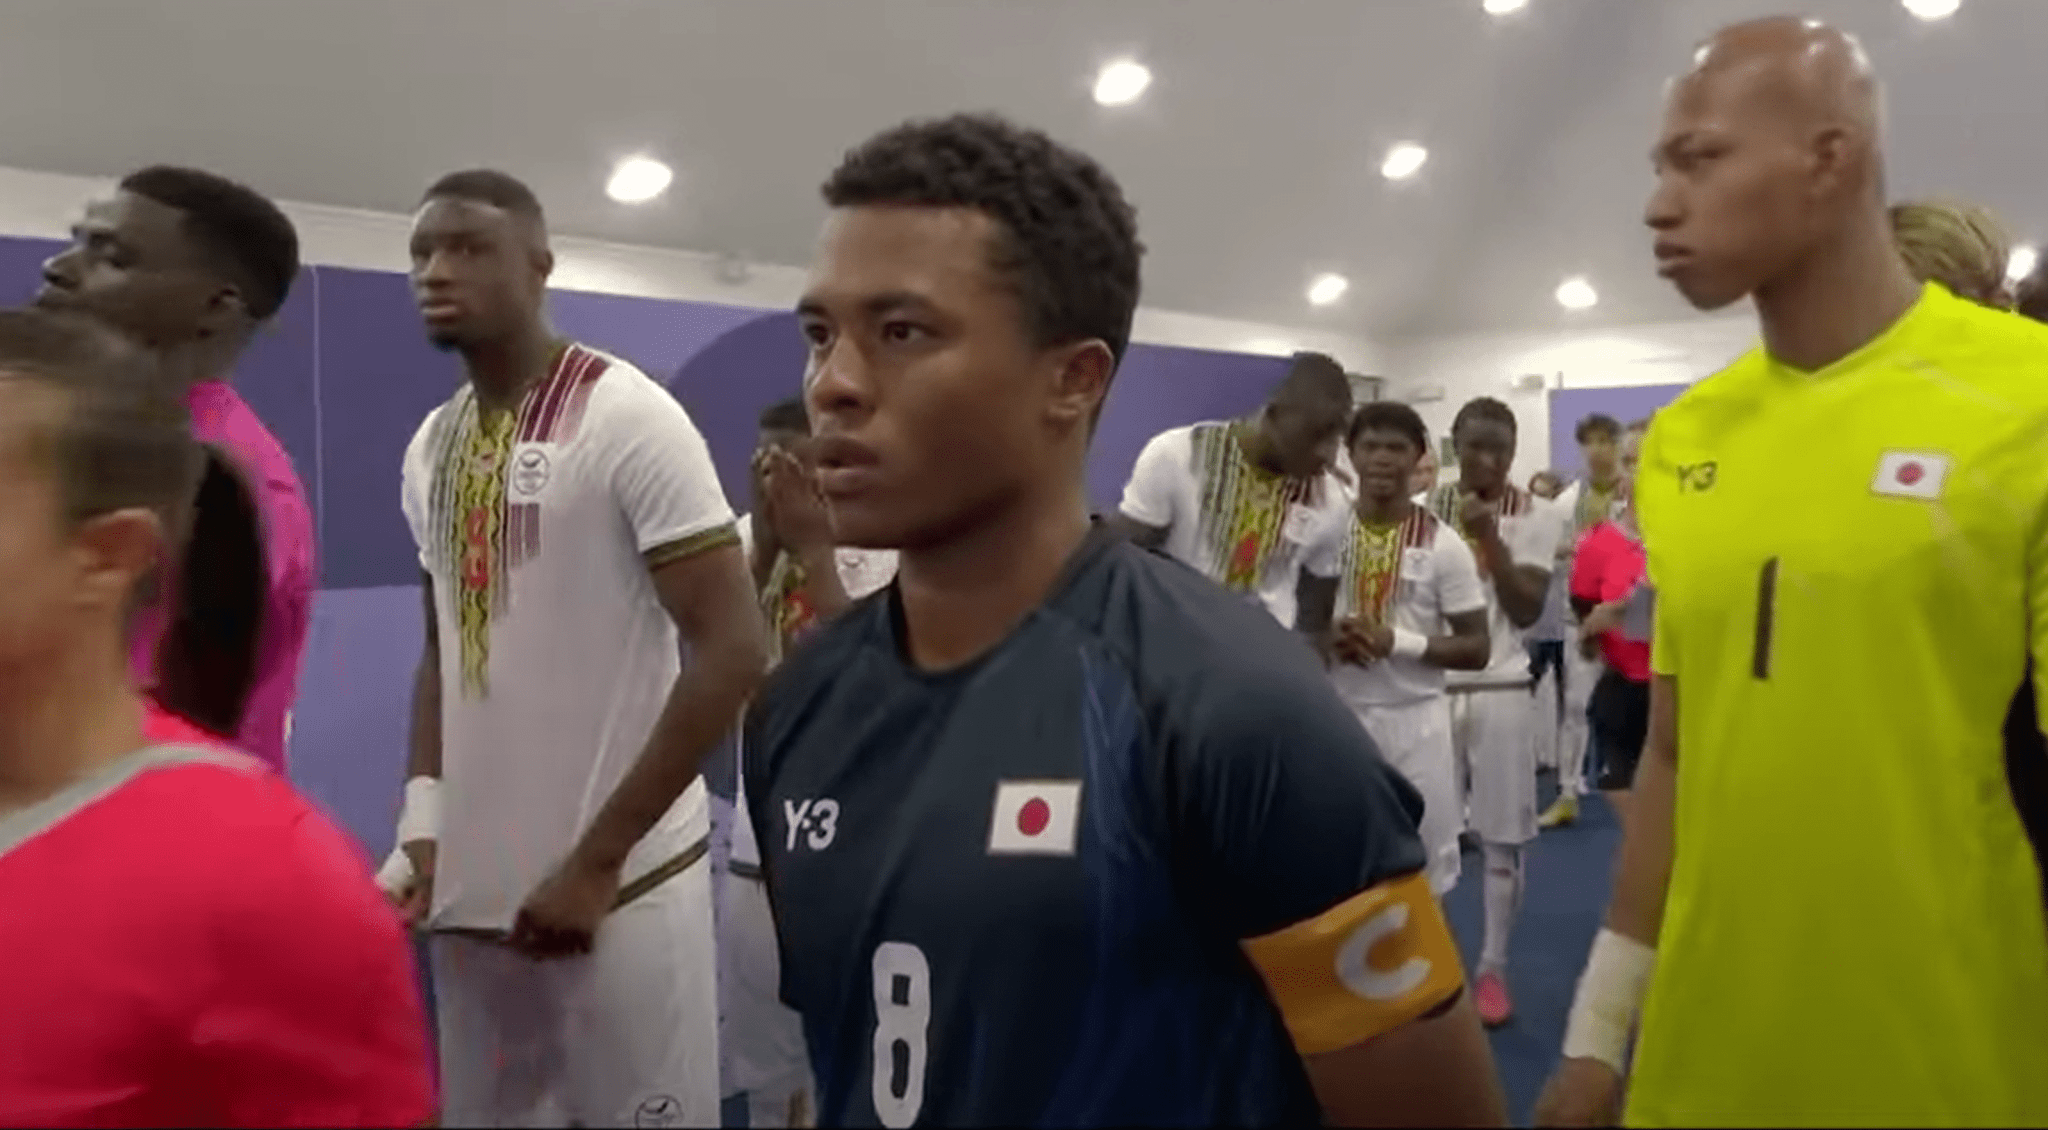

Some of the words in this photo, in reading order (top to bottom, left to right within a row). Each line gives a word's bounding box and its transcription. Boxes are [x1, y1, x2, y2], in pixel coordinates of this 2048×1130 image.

[1752, 556, 1779, 680] 1
[784, 799, 840, 851] Y-3
[1334, 901, 1433, 1000] C
[872, 941, 931, 1129] 8
